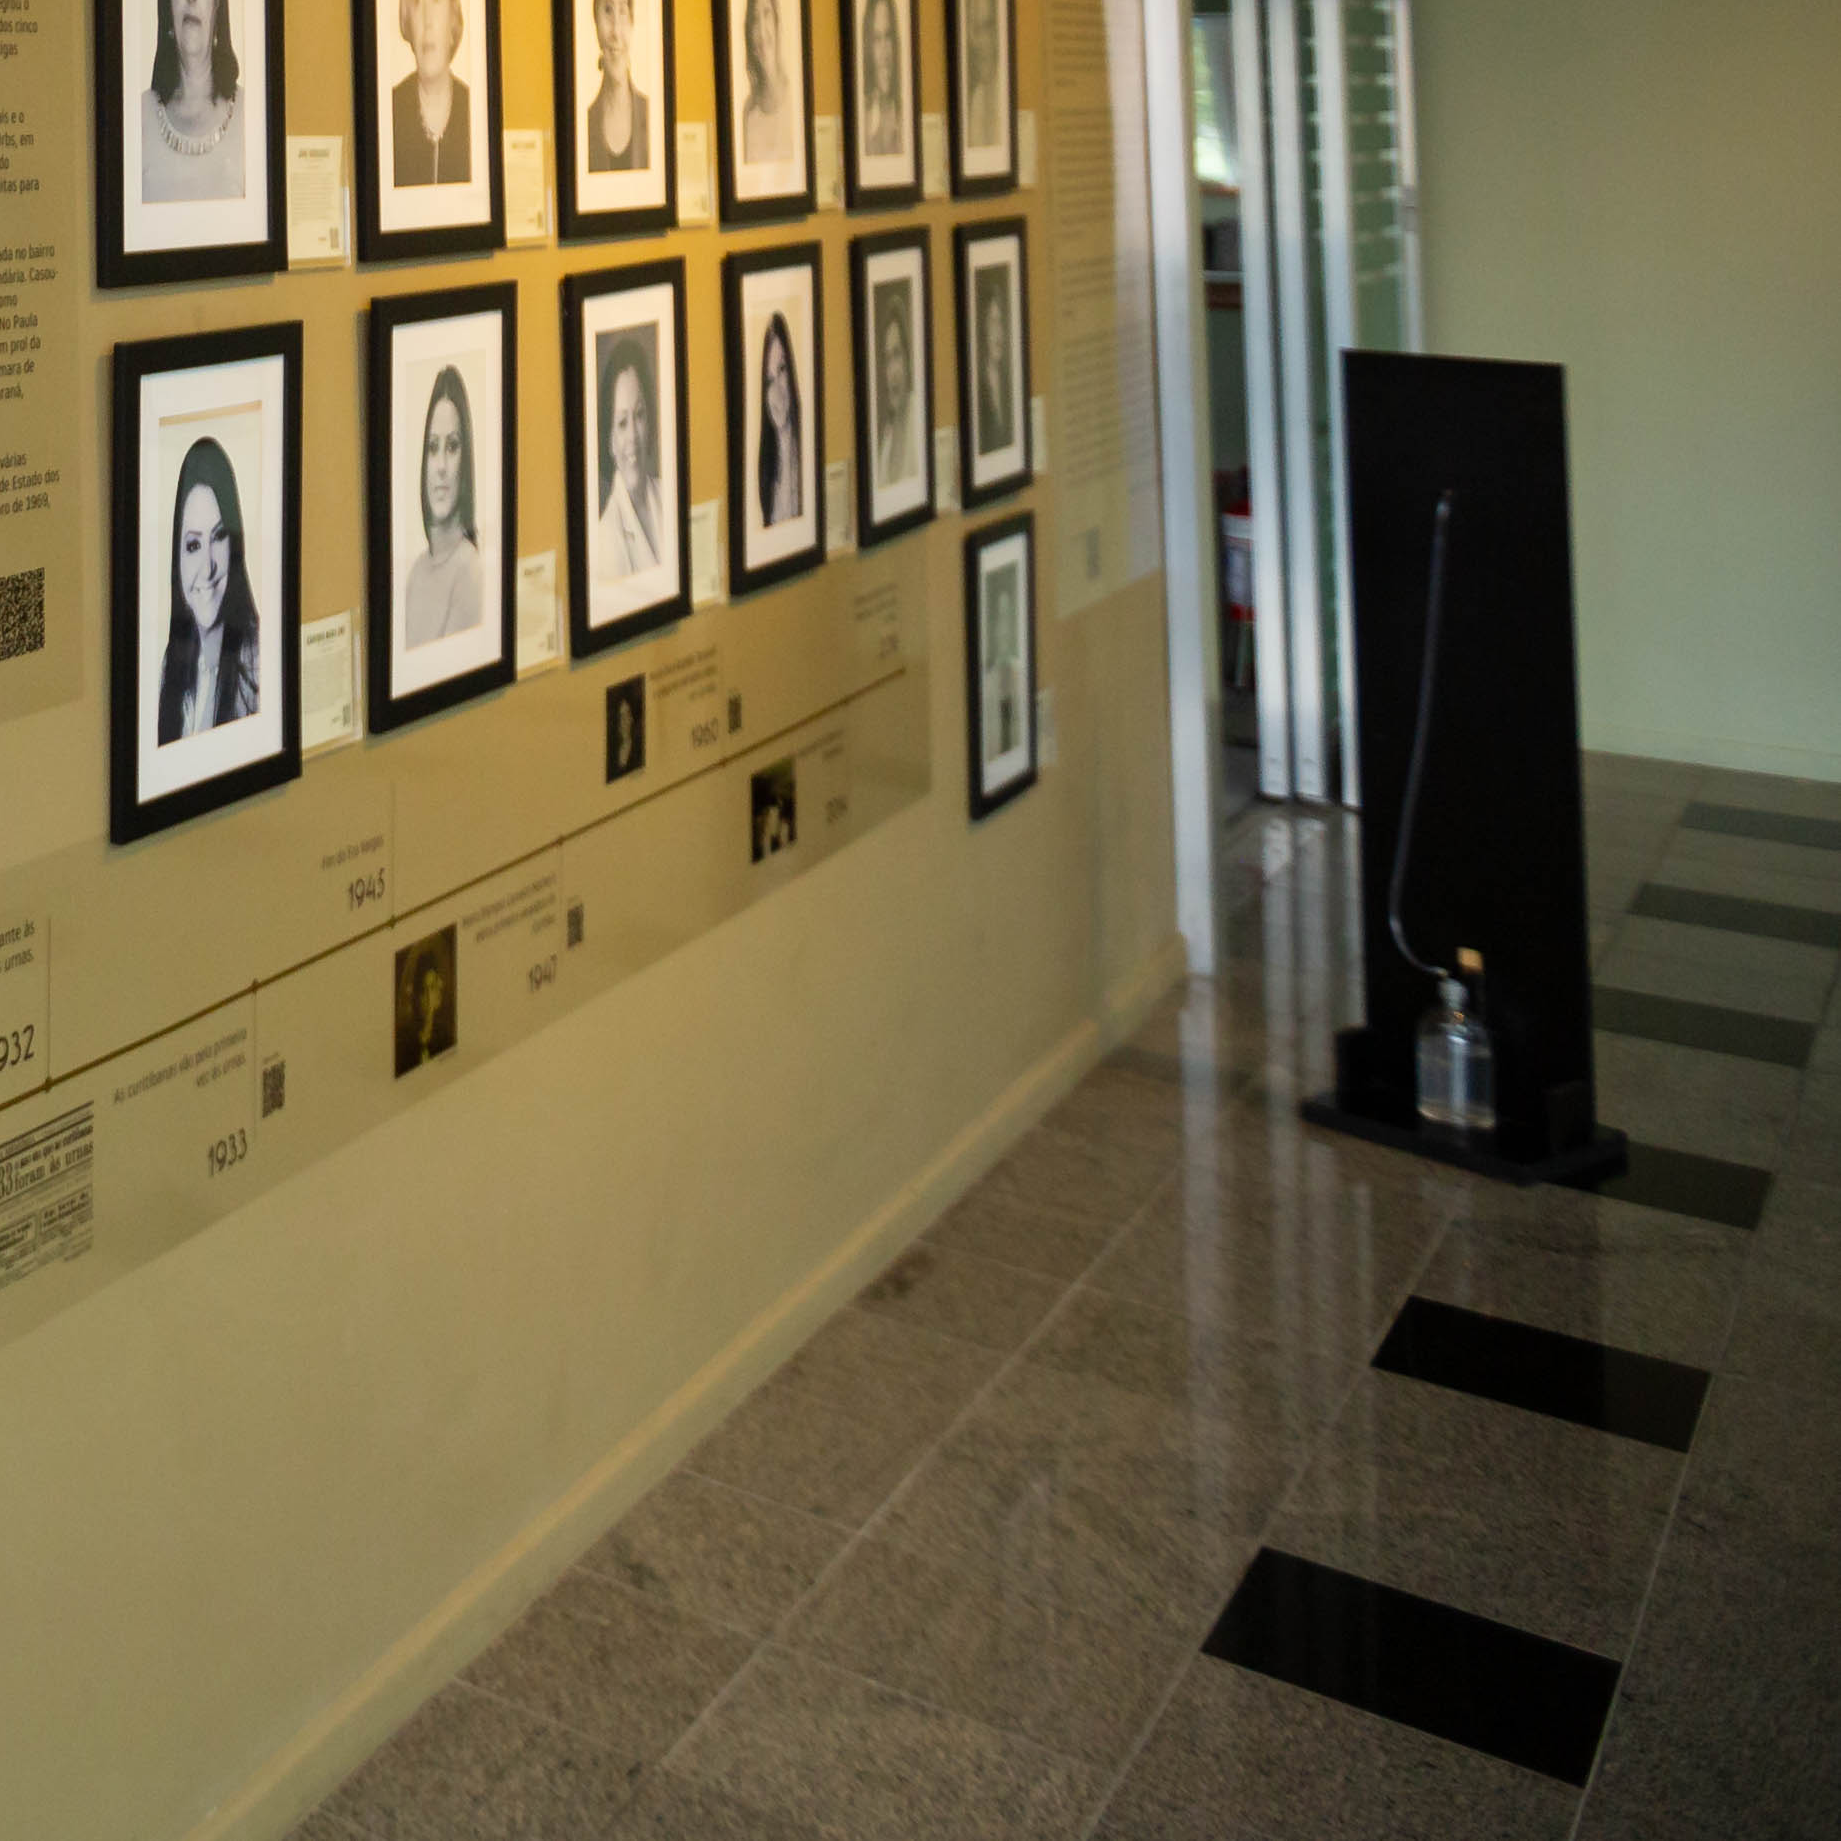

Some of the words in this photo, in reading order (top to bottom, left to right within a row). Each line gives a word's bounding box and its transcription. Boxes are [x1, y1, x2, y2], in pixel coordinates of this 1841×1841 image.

[348, 867, 386, 911] 1945
[24, 919, 35, 938] às
[207, 1126, 248, 1177] 1933
